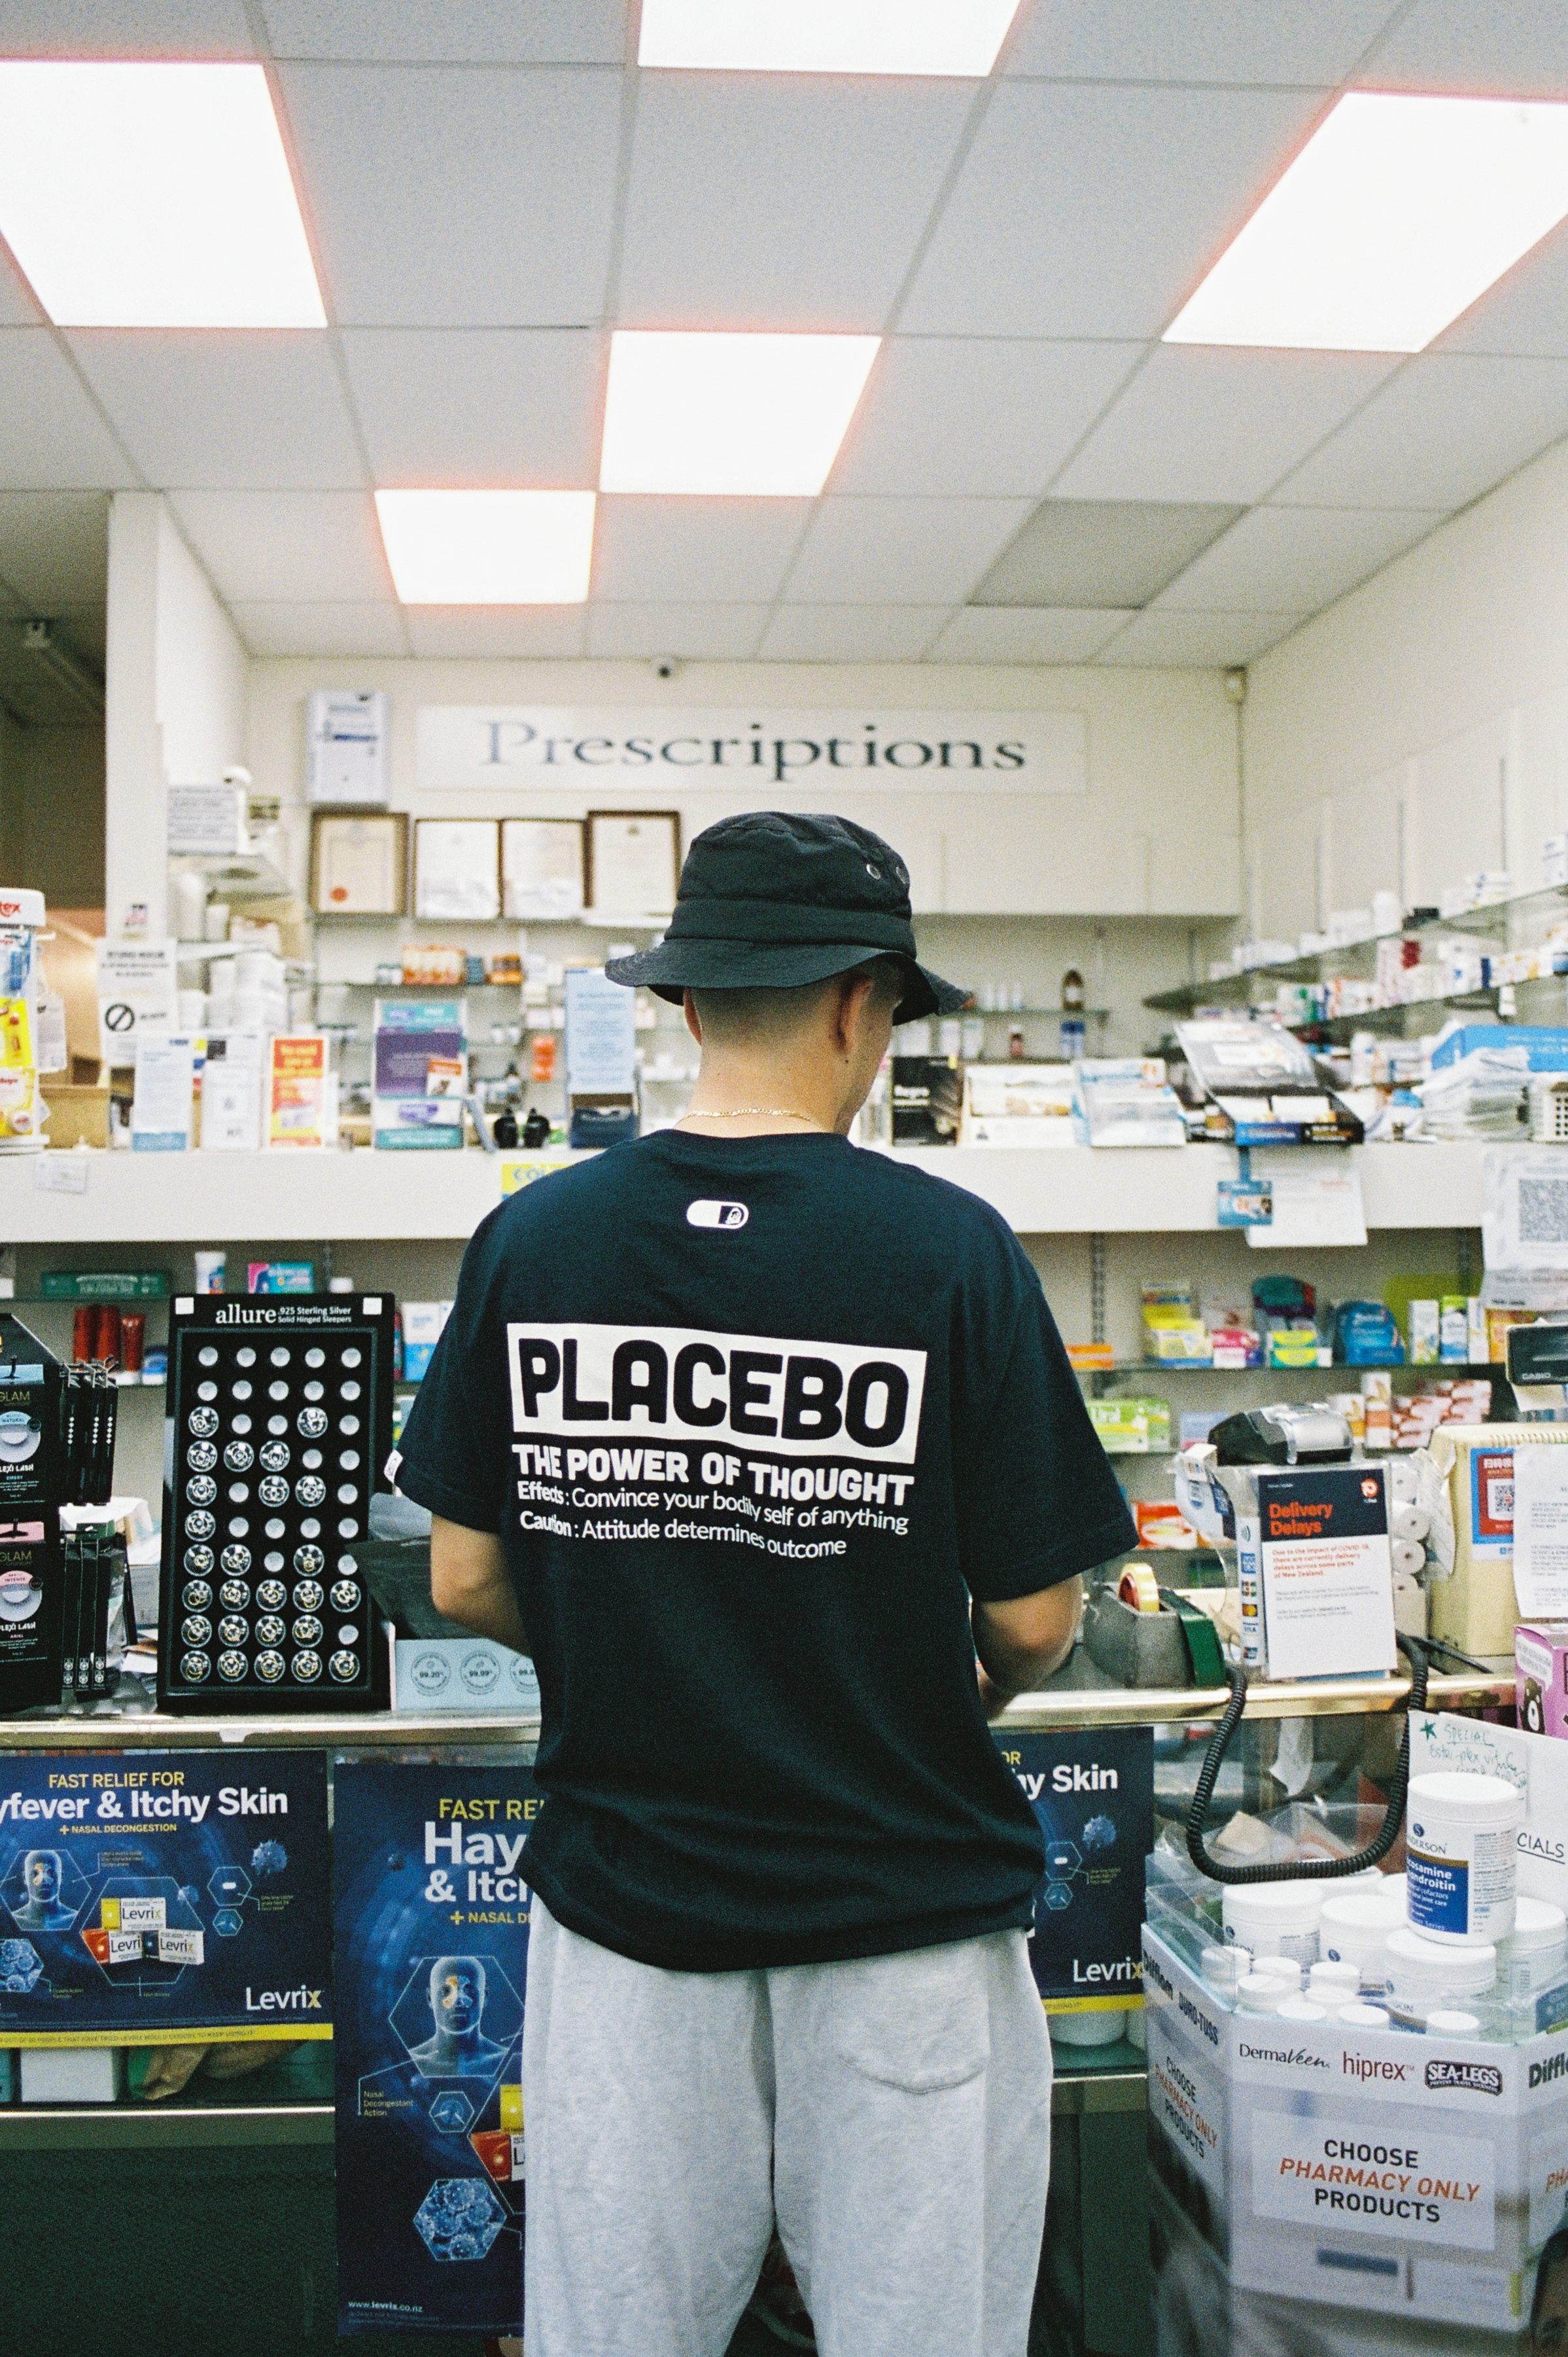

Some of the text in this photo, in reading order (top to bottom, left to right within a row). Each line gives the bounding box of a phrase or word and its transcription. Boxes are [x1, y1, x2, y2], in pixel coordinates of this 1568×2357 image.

[479, 721, 1028, 783] Prescriptions
[215, 1303, 277, 1324] allure
[296, 1306, 328, 1316] Sterling
[329, 1306, 352, 1315] Silver
[296, 1316, 321, 1324] Hinged
[518, 1338, 909, 1447] PLACEBO
[16, 1463, 34, 1472] LASH
[512, 1444, 915, 1506] THE POWER OF THOUGHT
[572, 1487, 659, 1508] Convince
[663, 1491, 708, 1511] your
[713, 1492, 762, 1522] bodily
[764, 1505, 793, 1526] self
[797, 1506, 819, 1527] of
[822, 1506, 909, 1536] anything
[1269, 1501, 1333, 1519] Delivery
[582, 1519, 660, 1540] Attitude
[664, 1520, 765, 1549] determines
[767, 1537, 847, 1559] outcome
[1270, 1519, 1322, 1537] Delays
[18, 1621, 36, 1630] LASH
[49, 1771, 184, 1788] FAST RELIEF FOR
[1052, 1764, 1119, 1792] Skin
[97, 1790, 124, 1819] &
[131, 1788, 211, 1823] Itchy
[218, 1787, 288, 1815] Skin
[439, 1798, 499, 1820] FAST
[72, 1824, 102, 1834] NASAL
[103, 1823, 177, 1834] DECONGESTION
[1517, 1832, 1565, 1858] CIALS
[425, 1870, 456, 1902] &
[122, 1907, 162, 1920] Levrix
[468, 1912, 513, 1924] NASAL
[111, 1936, 141, 1953] Levri
[160, 1939, 194, 1953] Levrix
[1073, 1957, 1143, 1983] Levrix
[245, 1985, 322, 2011] Levrix
[1179, 1991, 1218, 2046] DURO-TUSS
[1166, 2056, 1196, 2104] CHOOSE
[1428, 2063, 1499, 2087] SEA-LEGS
[364, 2099, 413, 2108] Decongestant
[1155, 2063, 1217, 2148] PHARMACY ONLY
[1165, 2099, 1204, 2158] PRODUCTS
[1324, 2139, 1419, 2169] CHOOSE
[1280, 2157, 1480, 2202] PHARMACY ONLY
[1314, 2188, 1440, 2224] PRODUCTS
[348, 2300, 423, 2313] www.levrix.co.nz
